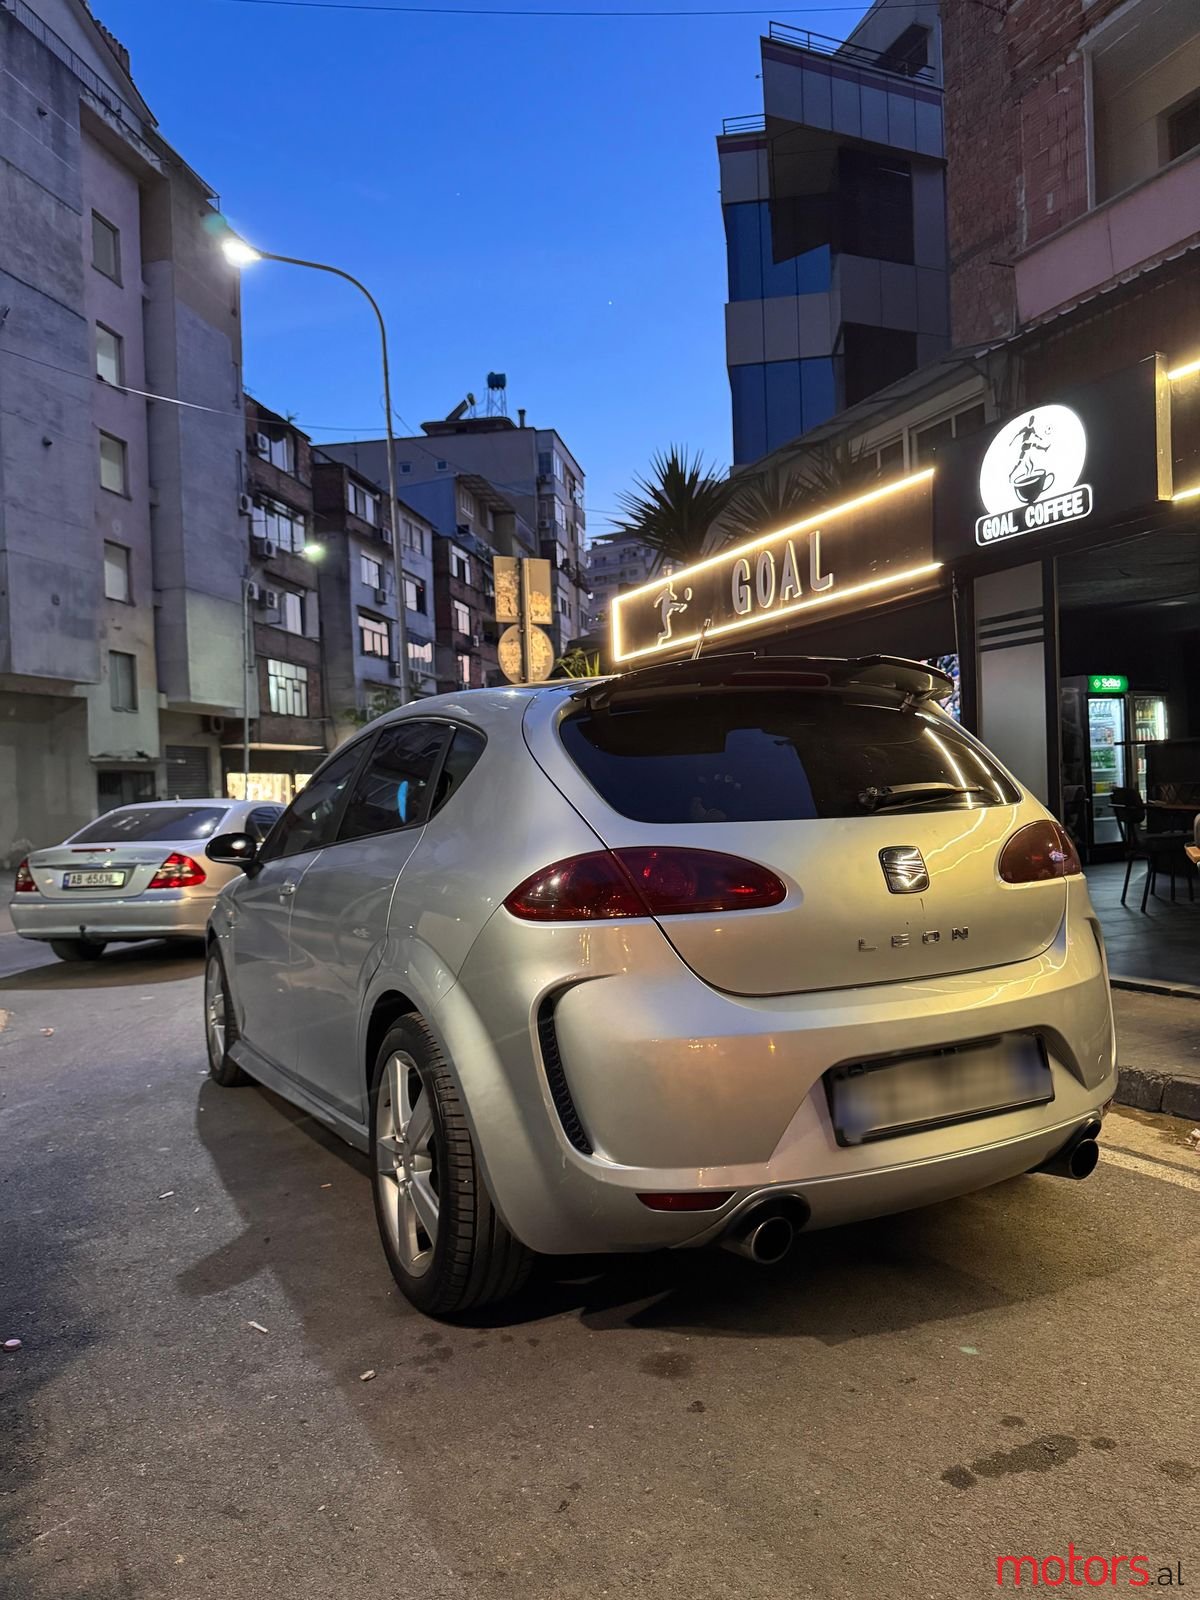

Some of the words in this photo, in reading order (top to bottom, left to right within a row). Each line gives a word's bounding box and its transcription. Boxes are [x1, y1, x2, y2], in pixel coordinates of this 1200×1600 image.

[982, 512, 1018, 540] GOAL
[1024, 490, 1083, 527] COFFEE
[732, 530, 833, 614] GOAL
[858, 926, 968, 952] LEON
